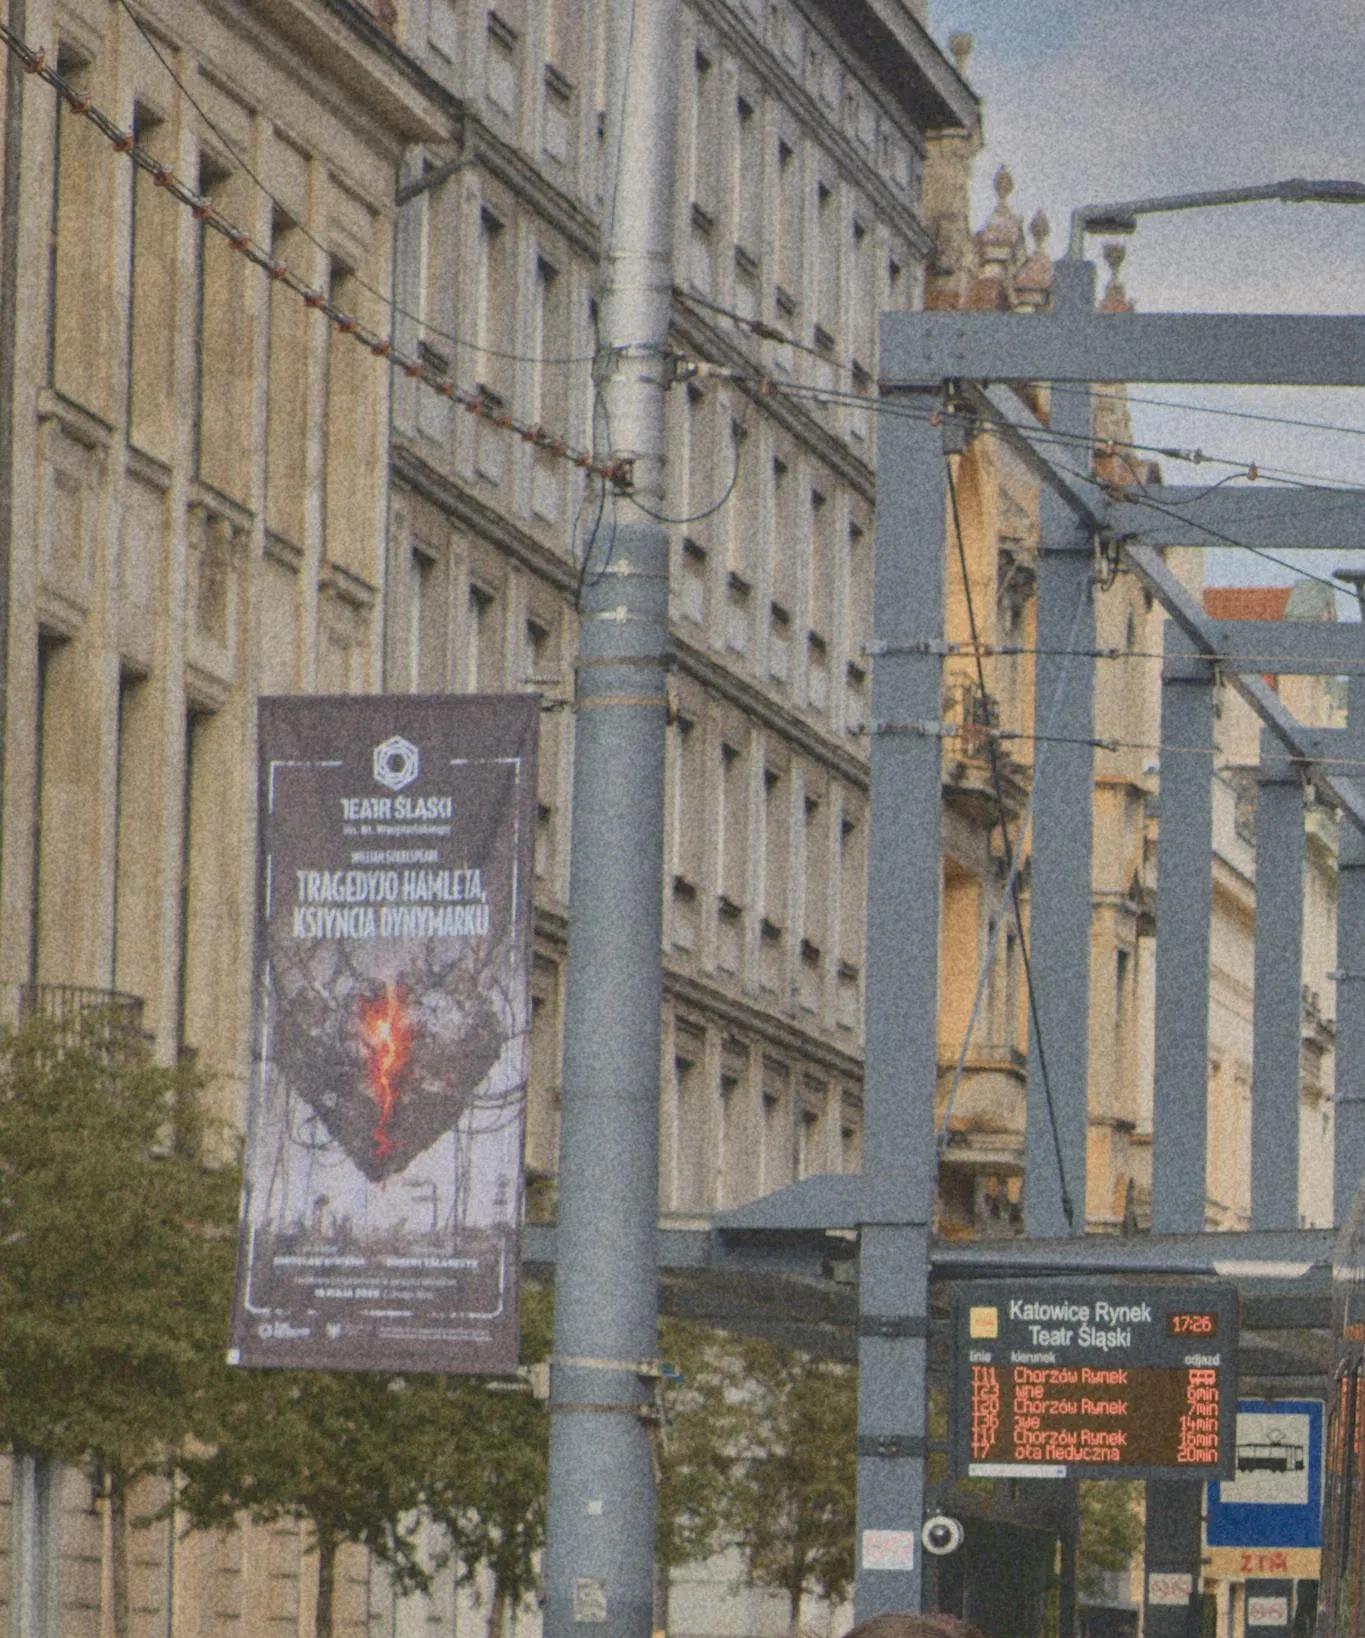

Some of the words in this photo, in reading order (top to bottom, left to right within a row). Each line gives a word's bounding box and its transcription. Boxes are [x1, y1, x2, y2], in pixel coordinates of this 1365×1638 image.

[340, 797, 392, 820] TEATR
[297, 869, 399, 903] TRAGEDYJO
[1009, 1299, 1089, 1323] Katowice
[1095, 1300, 1152, 1326] Rynek
[1172, 1315, 1212, 1333] 17:26
[1029, 1326, 1074, 1347] Teatr
[1078, 1322, 1131, 1351] Śląski
[1011, 1350, 1056, 1364] kierunek
[1184, 1353, 1221, 1367] odjazd
